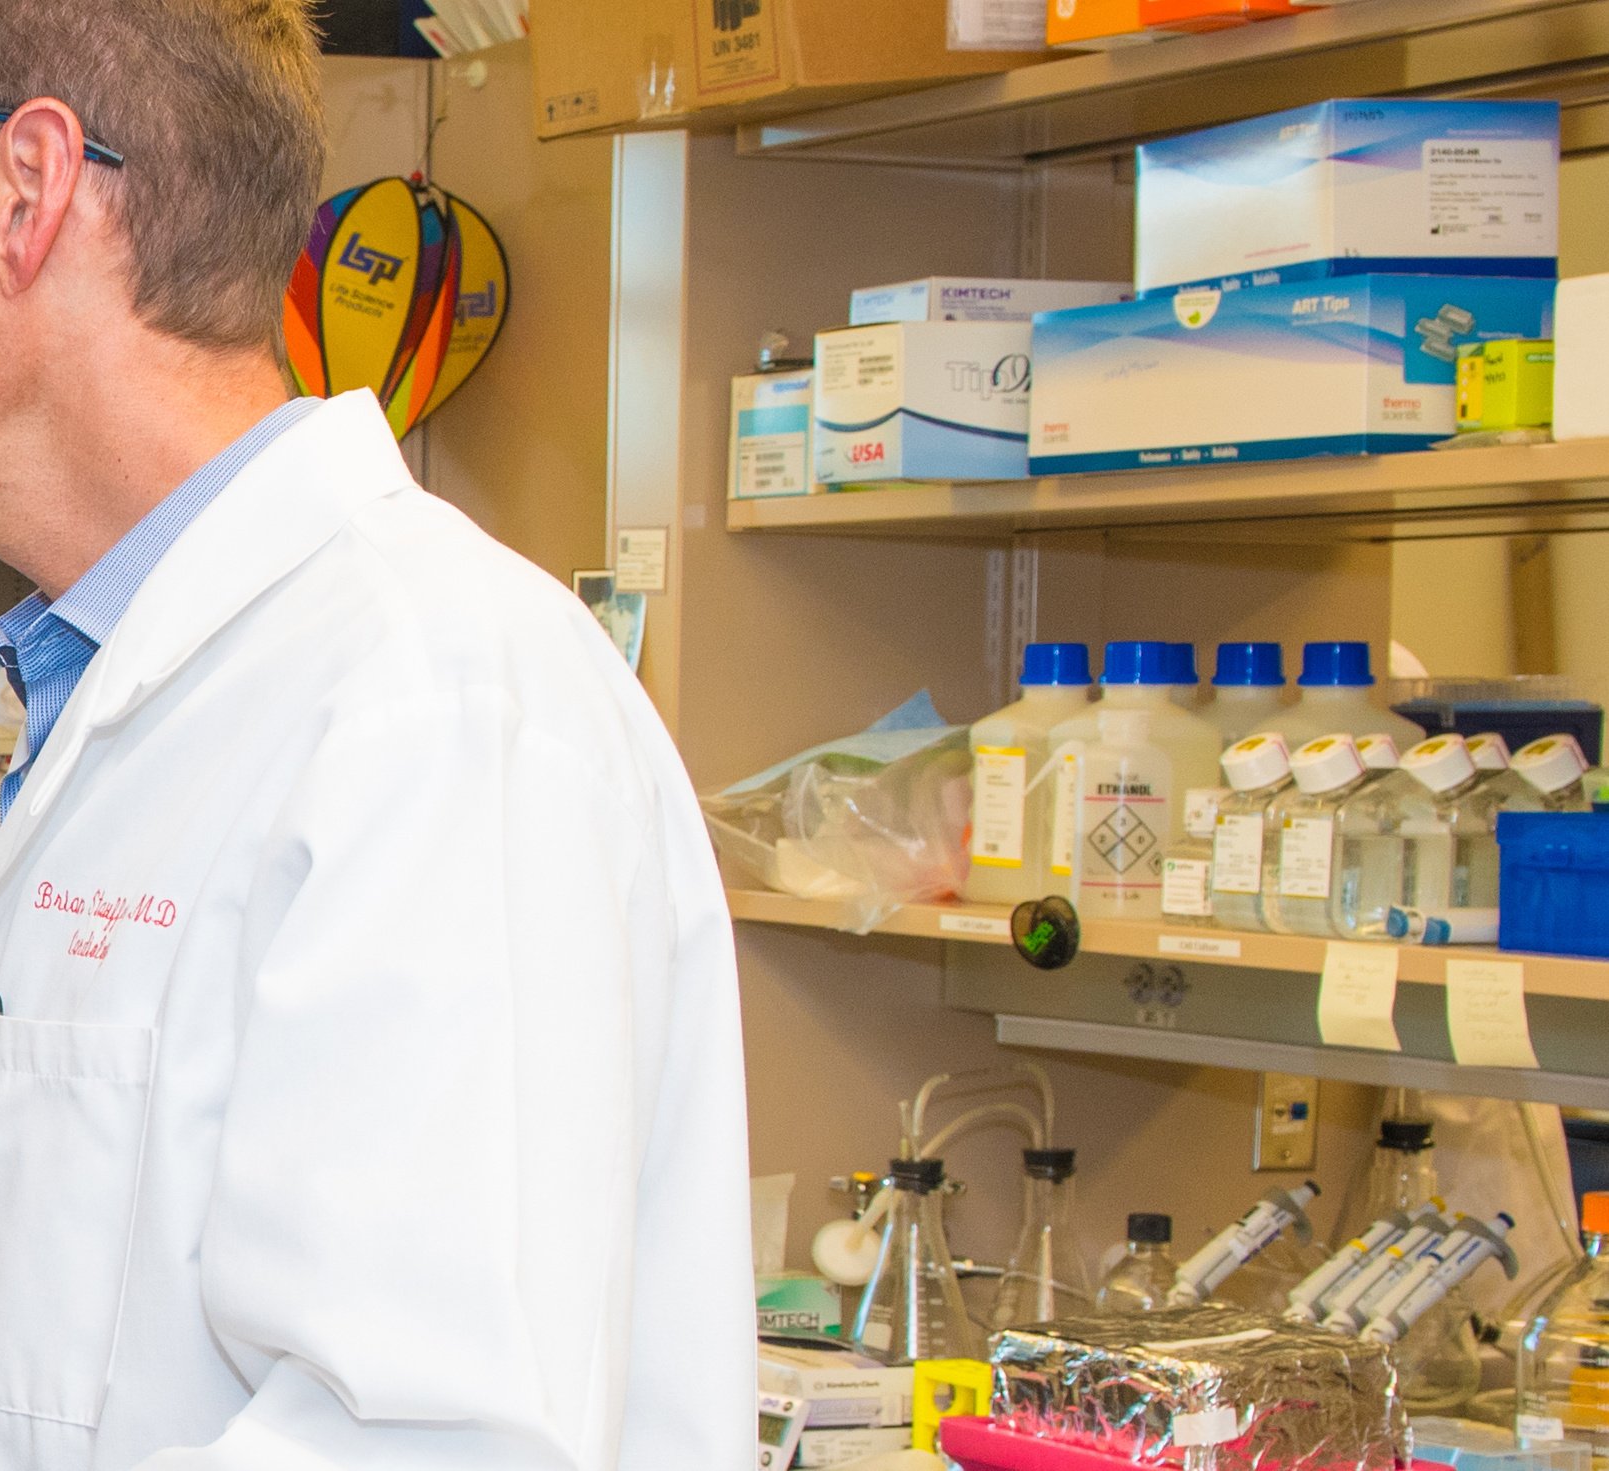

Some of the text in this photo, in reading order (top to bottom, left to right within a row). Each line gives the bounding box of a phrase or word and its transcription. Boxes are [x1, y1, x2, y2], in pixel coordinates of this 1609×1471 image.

[712, 40, 731, 56] UN
[940, 286, 1012, 300] KIMTECH
[1292, 295, 1350, 314] ART Tips
[850, 443, 885, 463] USA
[1097, 783, 1152, 796] ETHANOL
[34, 881, 86, 915] Brian
